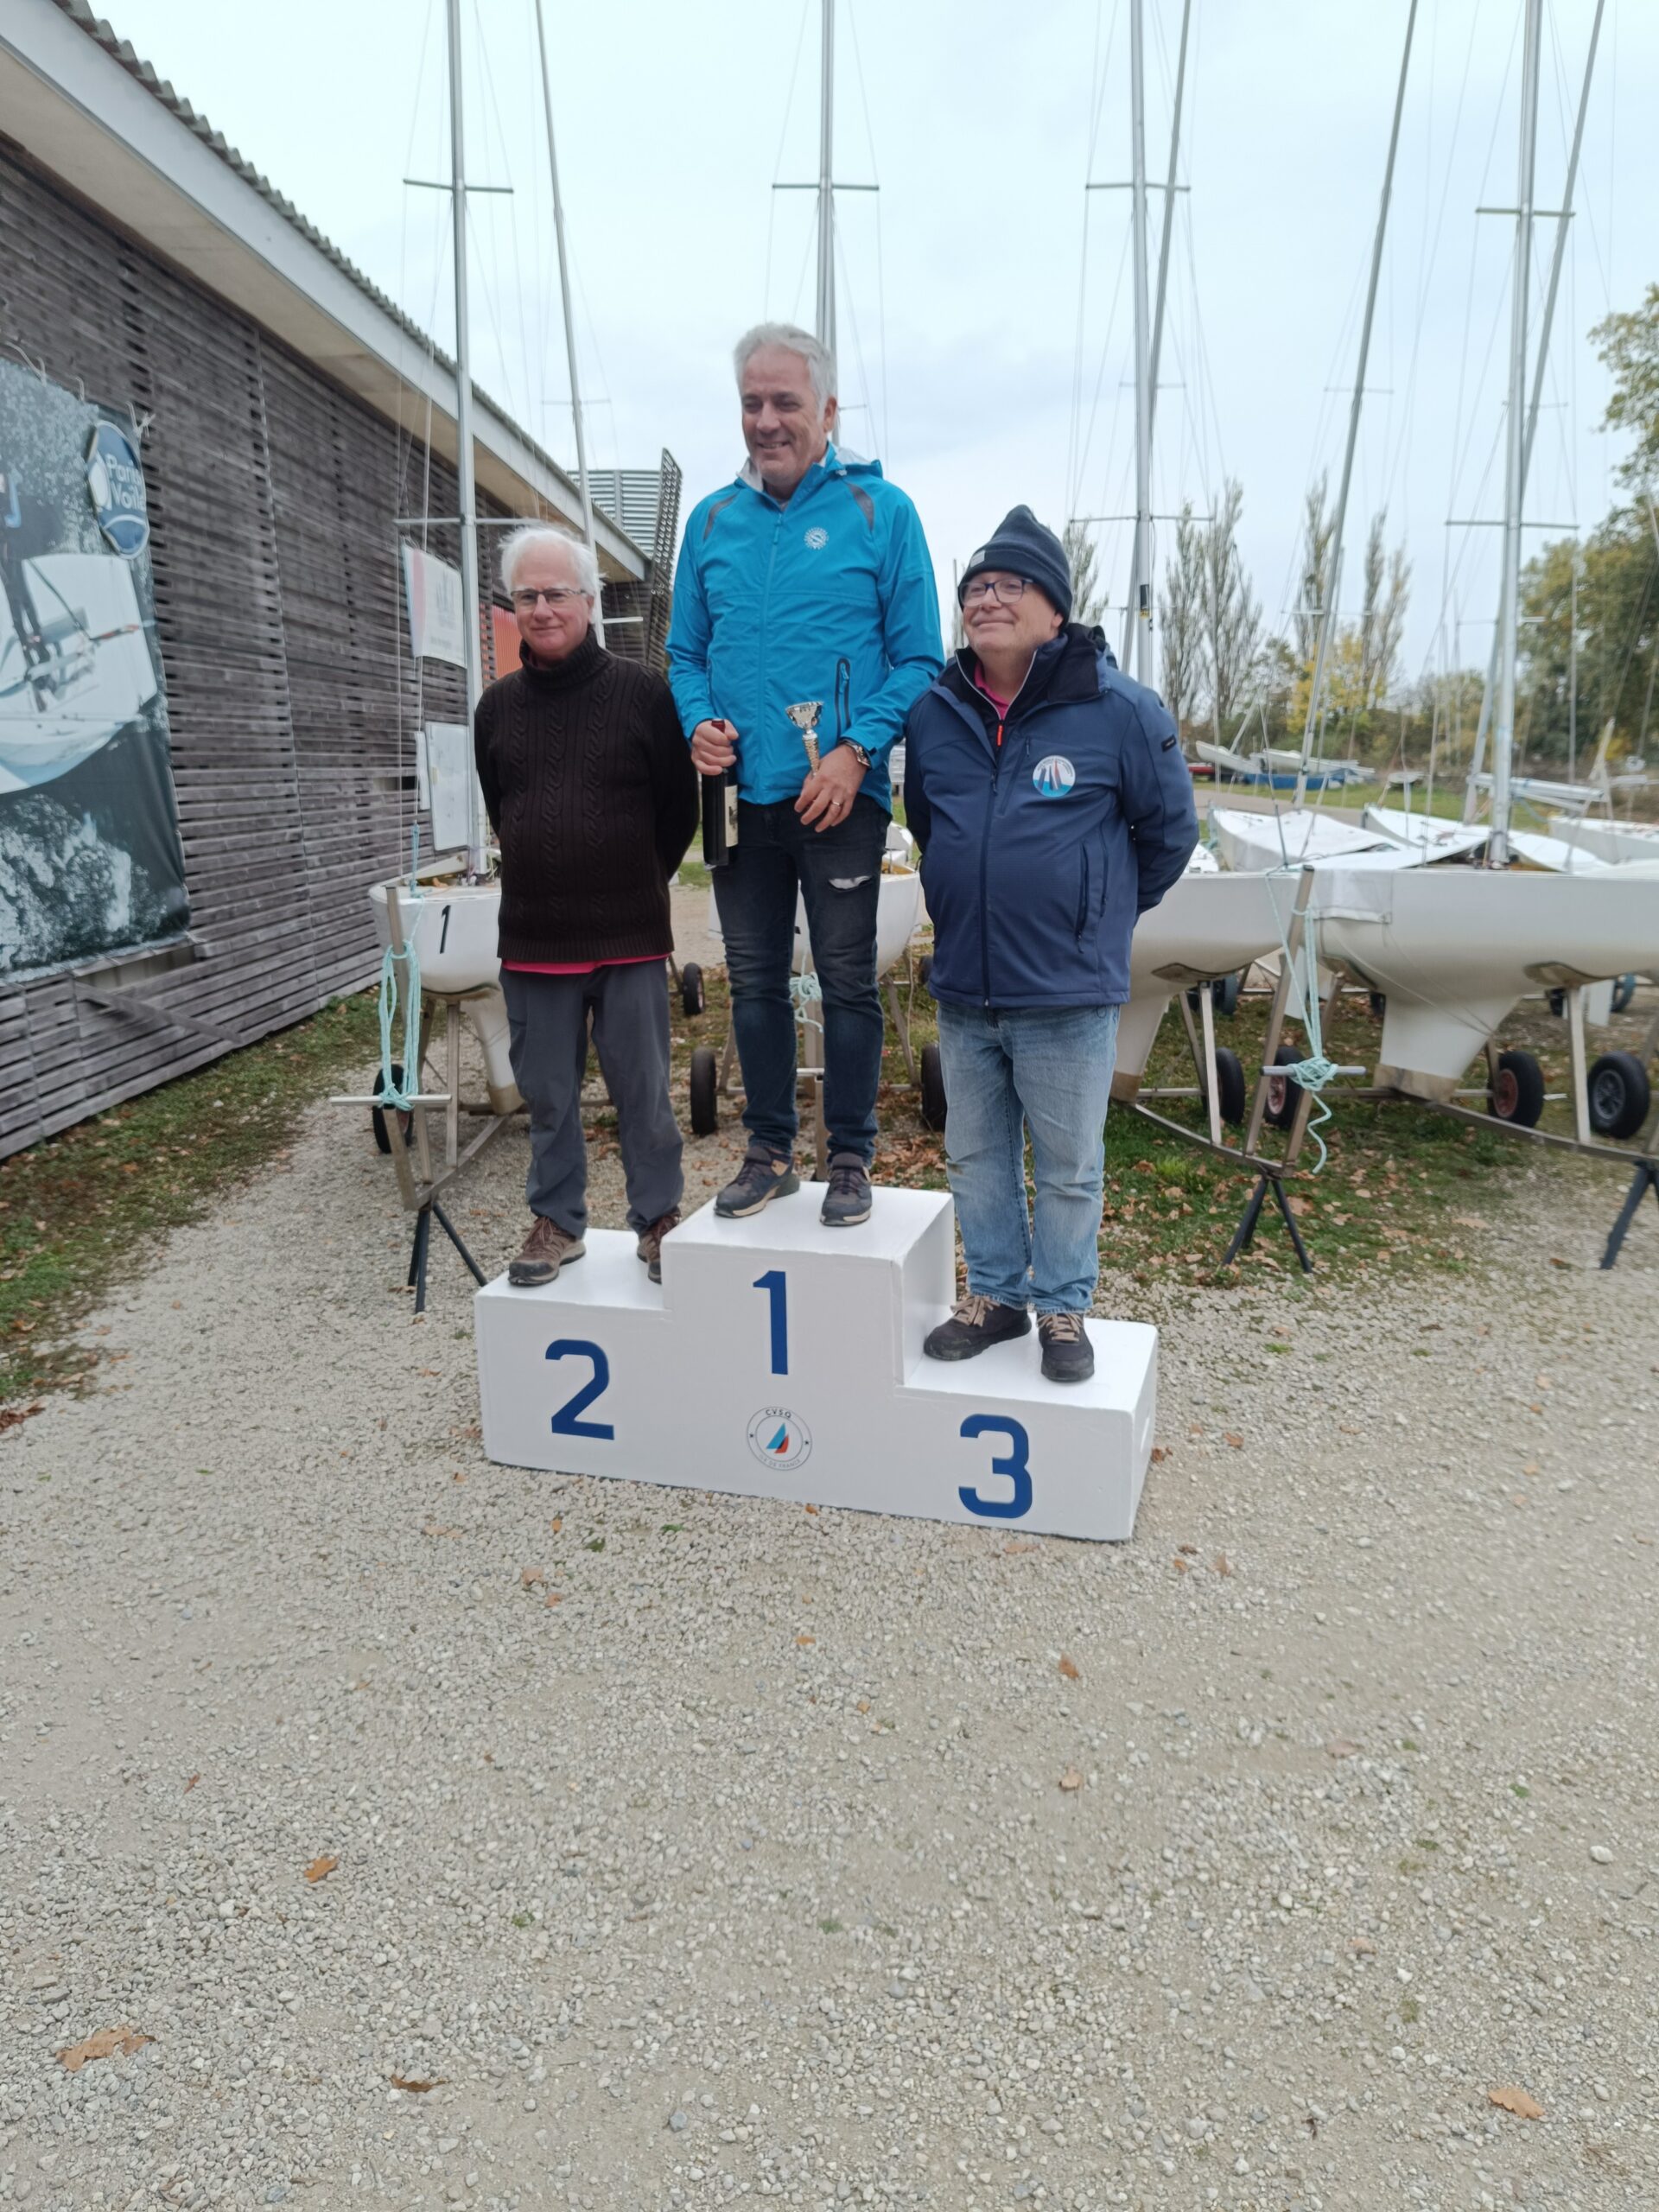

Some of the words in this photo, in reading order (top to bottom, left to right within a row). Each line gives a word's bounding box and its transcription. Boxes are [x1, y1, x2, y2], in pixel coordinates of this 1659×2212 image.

[110, 481, 146, 512] Voile
[440, 905, 451, 954] 1
[753, 1270, 788, 1375] 1
[545, 1338, 614, 1440] 2
[766, 1408, 791, 1418] CVSQ
[958, 1414, 1033, 1518] 3
